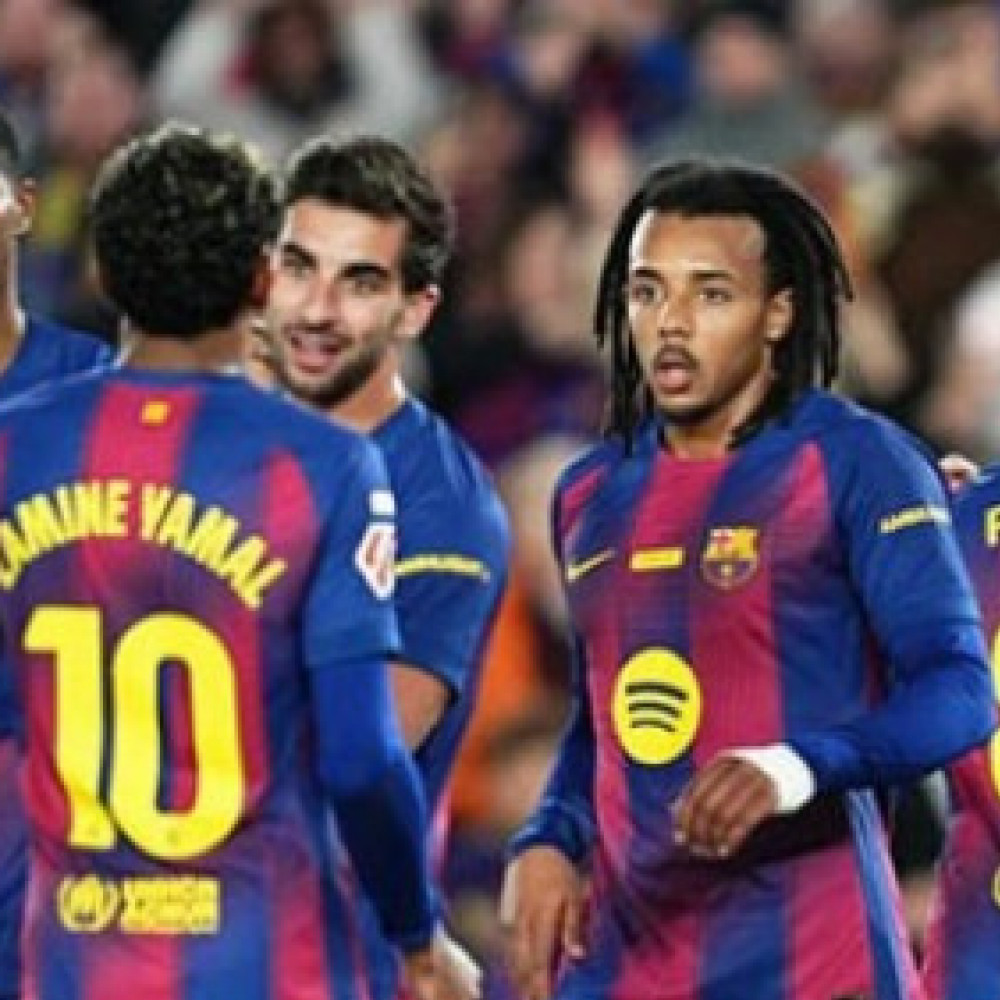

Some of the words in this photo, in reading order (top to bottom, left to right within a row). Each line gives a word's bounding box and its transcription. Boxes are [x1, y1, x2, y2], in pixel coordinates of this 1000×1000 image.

[0, 478, 131, 590] AMINE
[139, 482, 289, 609] YAMAL
[23, 605, 246, 860] 10
